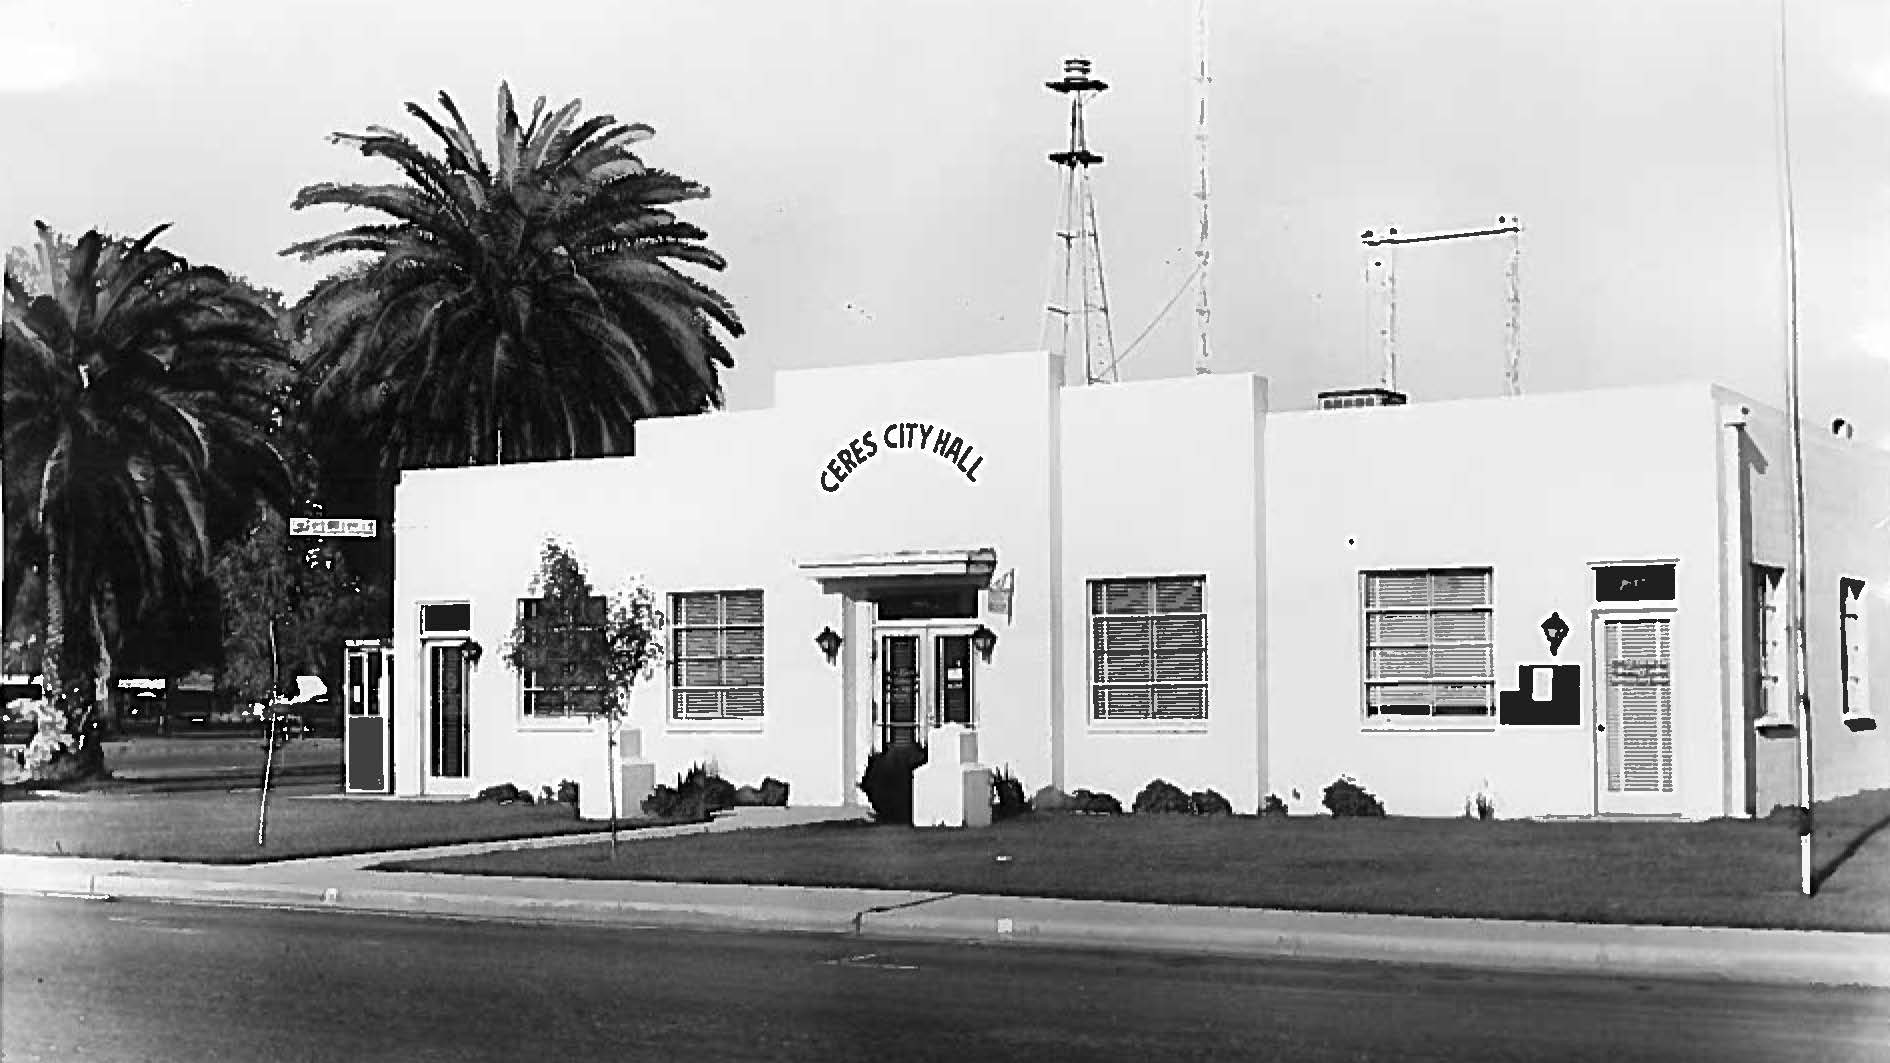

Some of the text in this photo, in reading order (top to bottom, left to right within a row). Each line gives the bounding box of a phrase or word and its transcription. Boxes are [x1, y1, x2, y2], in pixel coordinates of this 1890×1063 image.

[820, 422, 984, 493] CERES CITY HALL
